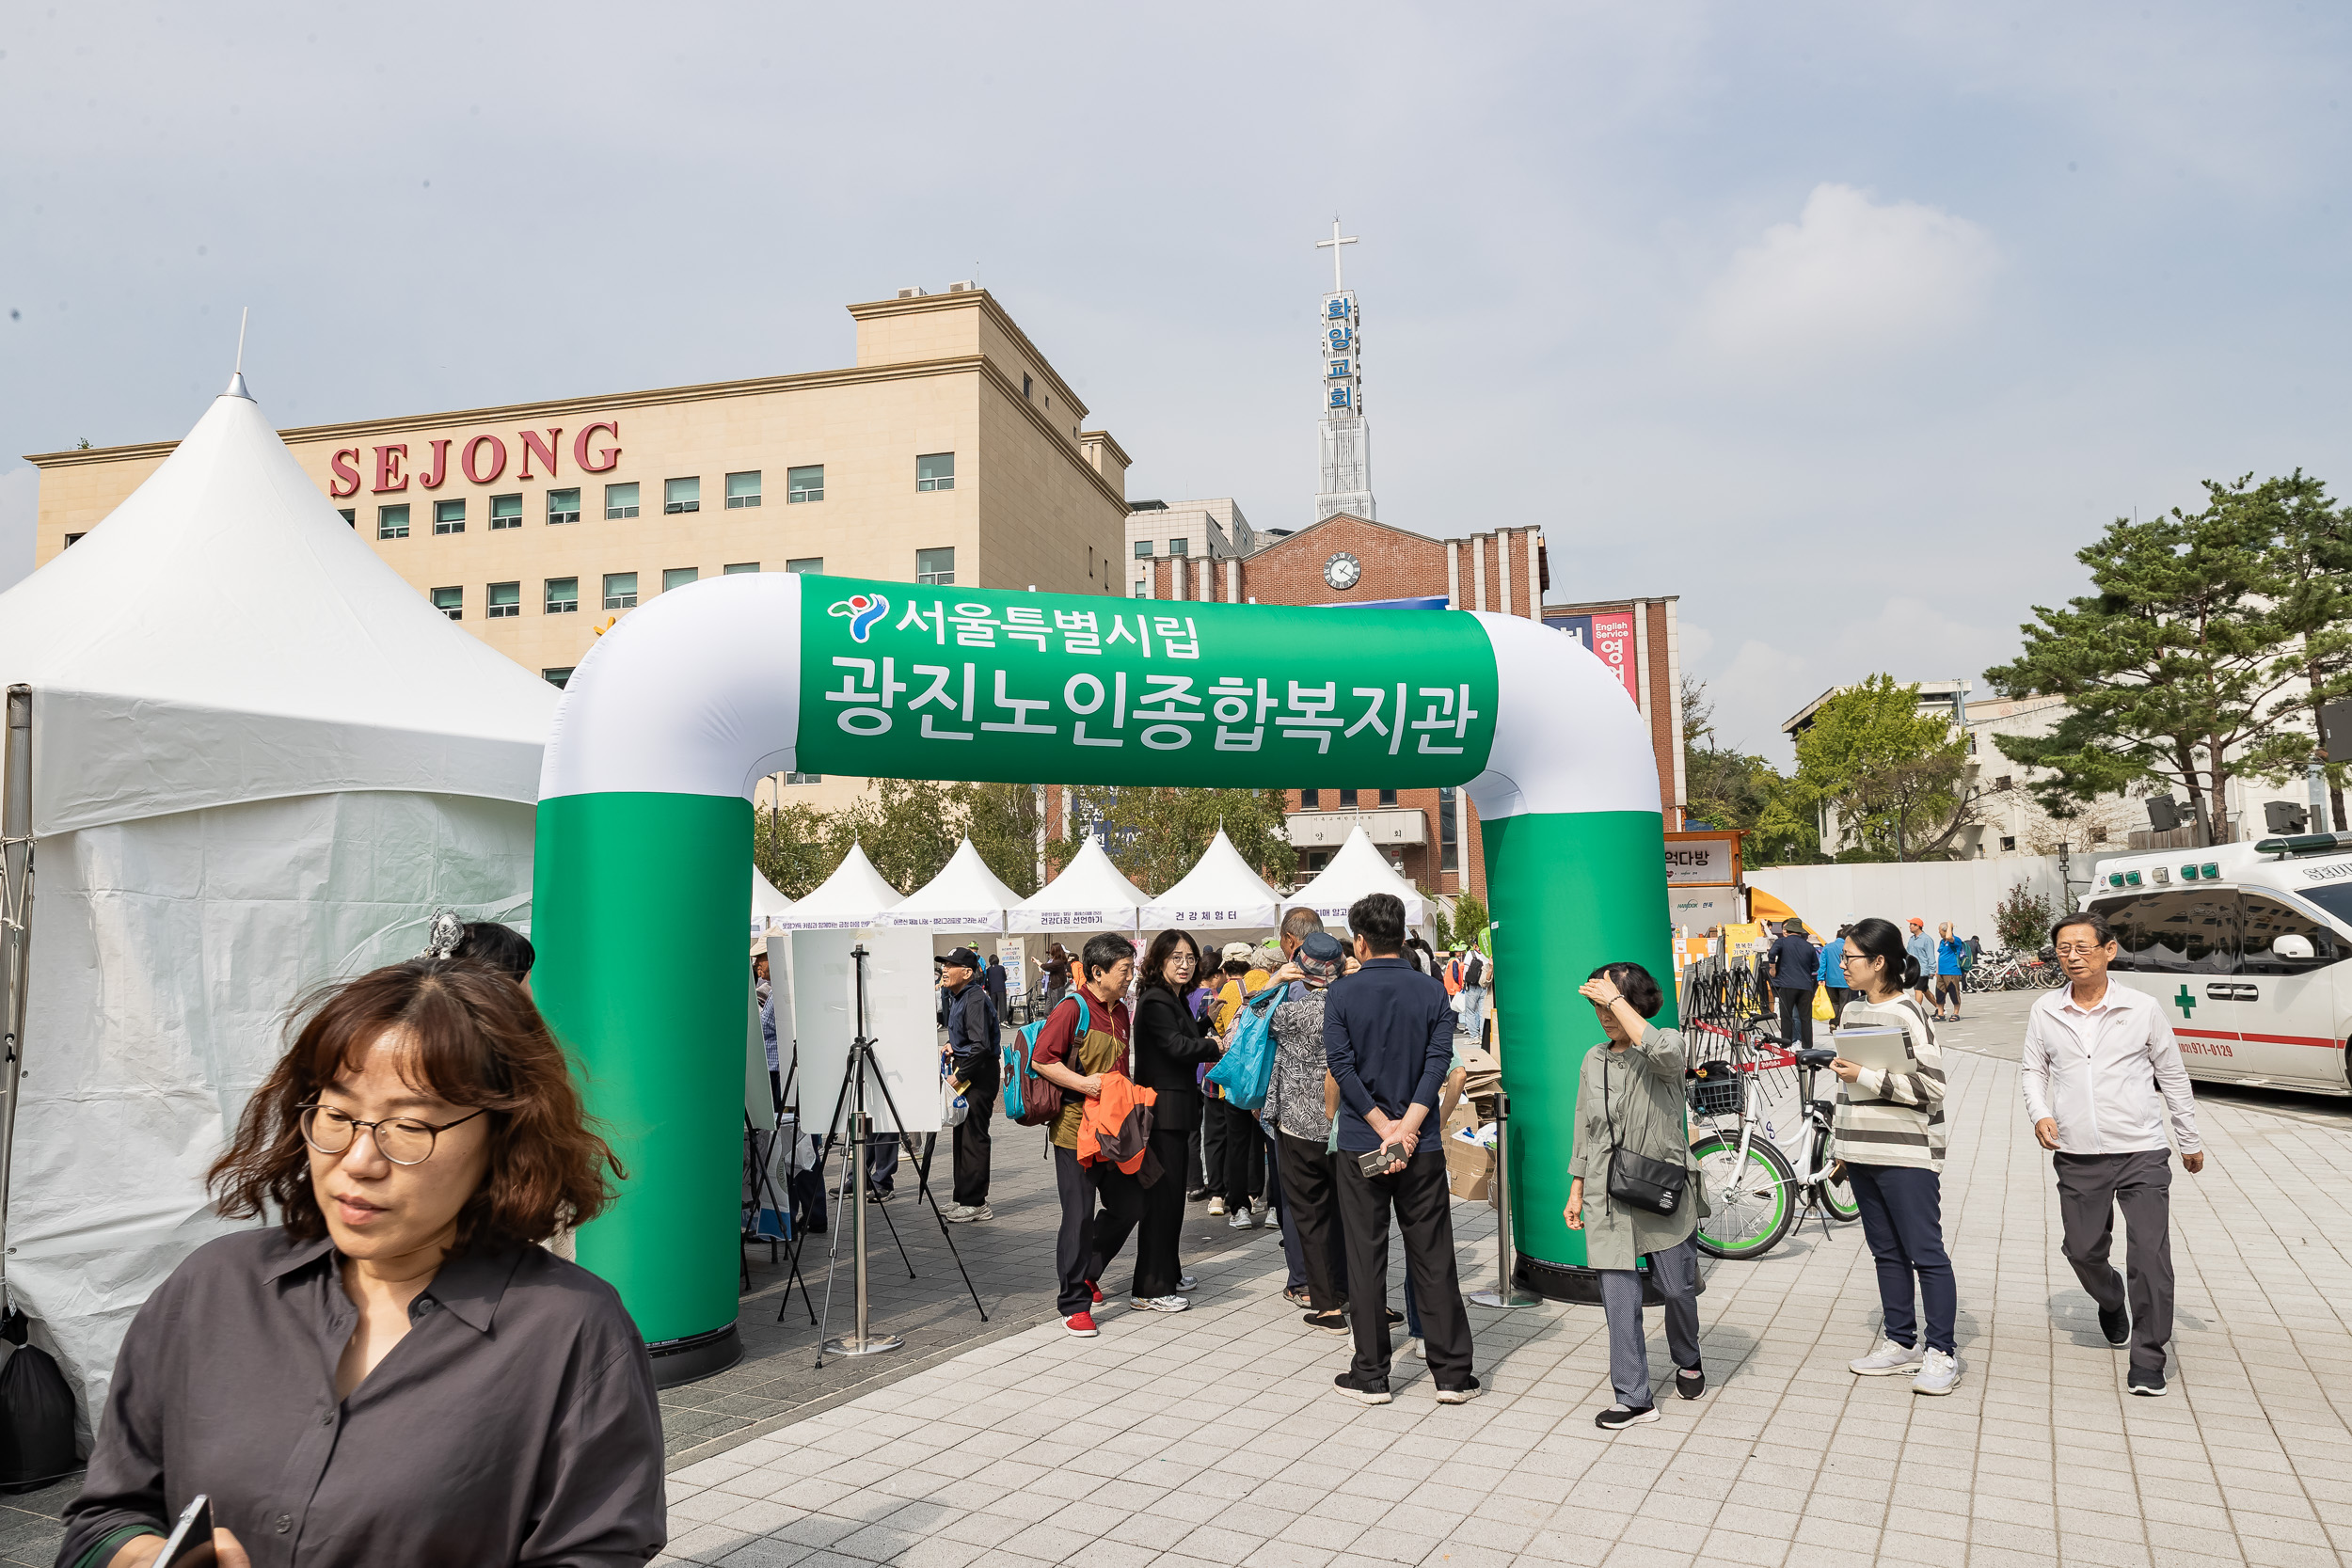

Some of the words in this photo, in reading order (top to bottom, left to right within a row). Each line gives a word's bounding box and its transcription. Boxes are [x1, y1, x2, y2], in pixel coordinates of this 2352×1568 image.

[1327, 297, 1352, 407] 화양교회
[330, 420, 622, 498] SEJONG
[896, 600, 1200, 659] 서울특별시립
[1596, 622, 1628, 631] English
[1596, 630, 1629, 640] Service
[825, 657, 1479, 755] 광진노인종합복지관
[1041, 916, 1071, 926] 건강다짐
[1073, 915, 1103, 924] 선언하기
